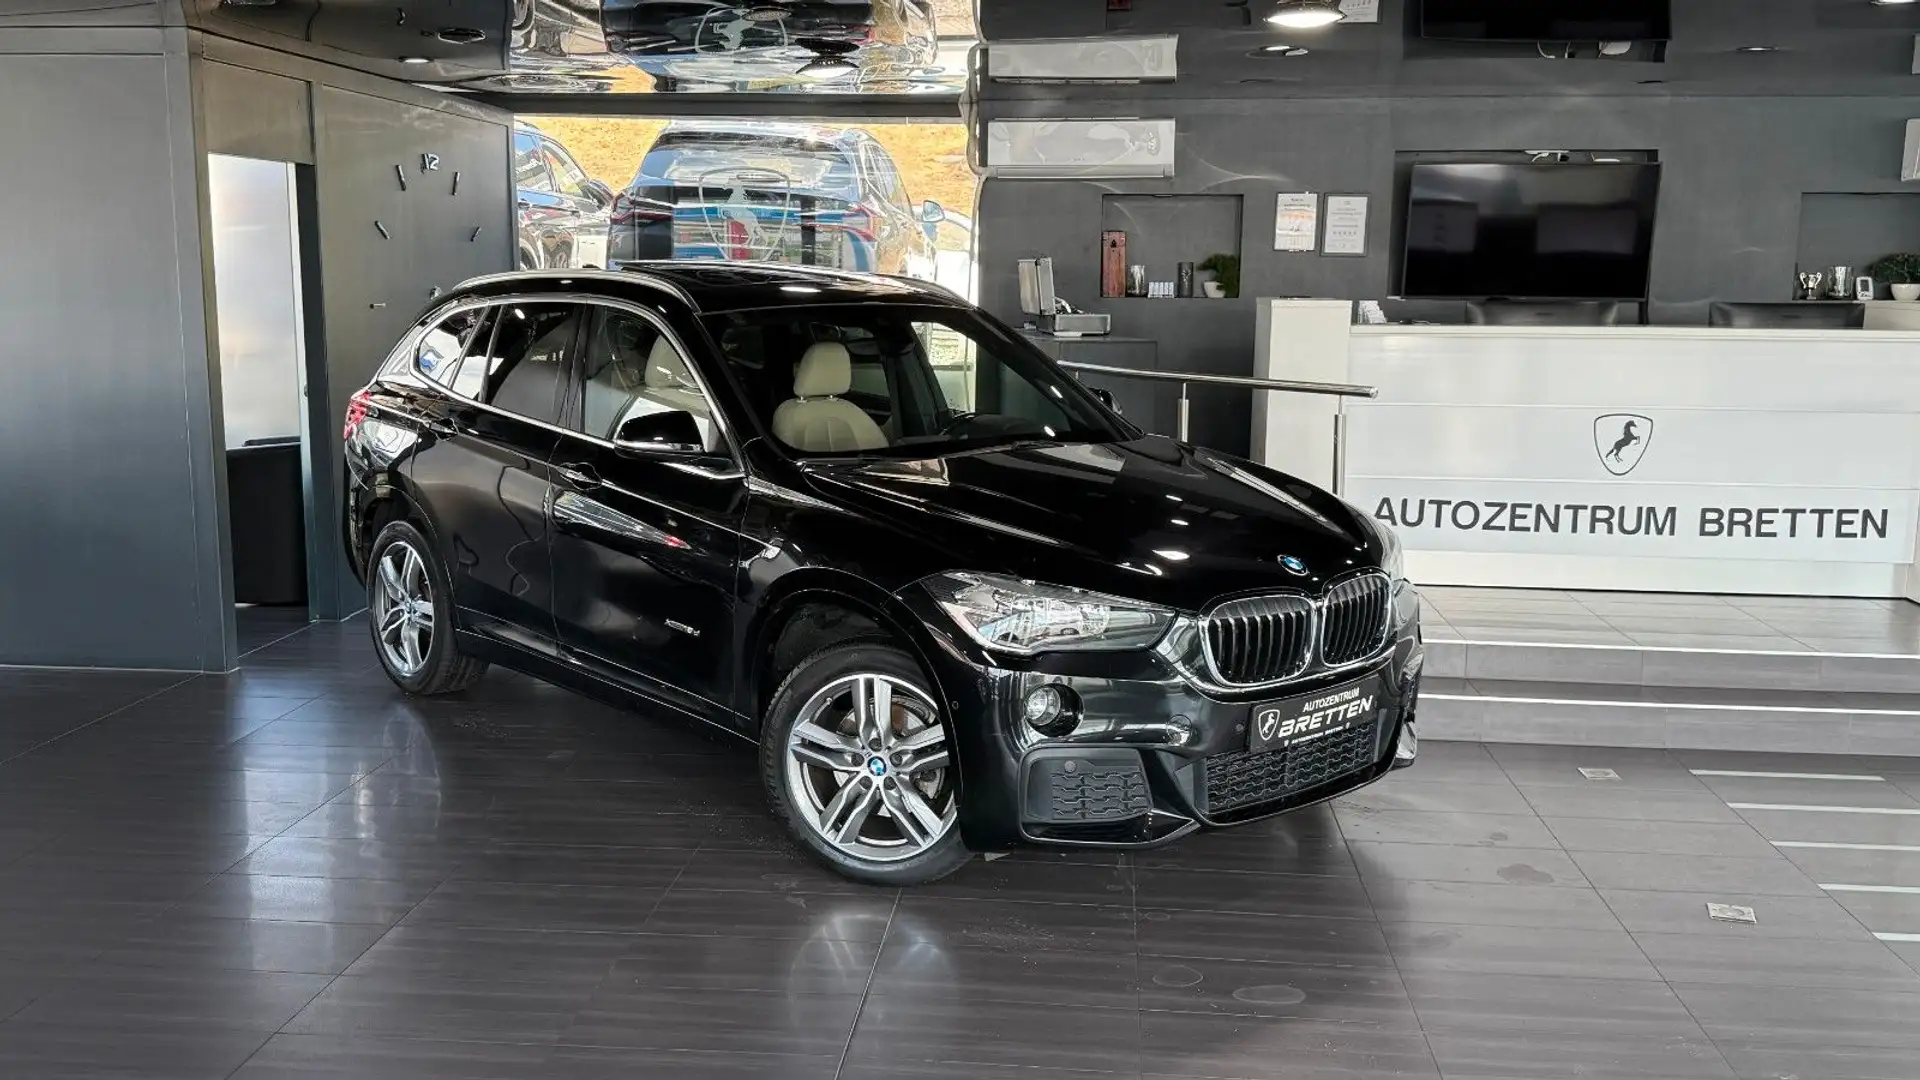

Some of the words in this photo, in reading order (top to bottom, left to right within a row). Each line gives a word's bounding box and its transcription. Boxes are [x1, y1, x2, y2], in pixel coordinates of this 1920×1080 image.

[421, 153, 440, 170] 12
[1374, 496, 1677, 536] AUTOZENTRUM
[1699, 507, 1889, 539] BRETTEN
[1278, 695, 1373, 738] BRETTEN
[1302, 687, 1360, 712] AUTOZENTRUM
